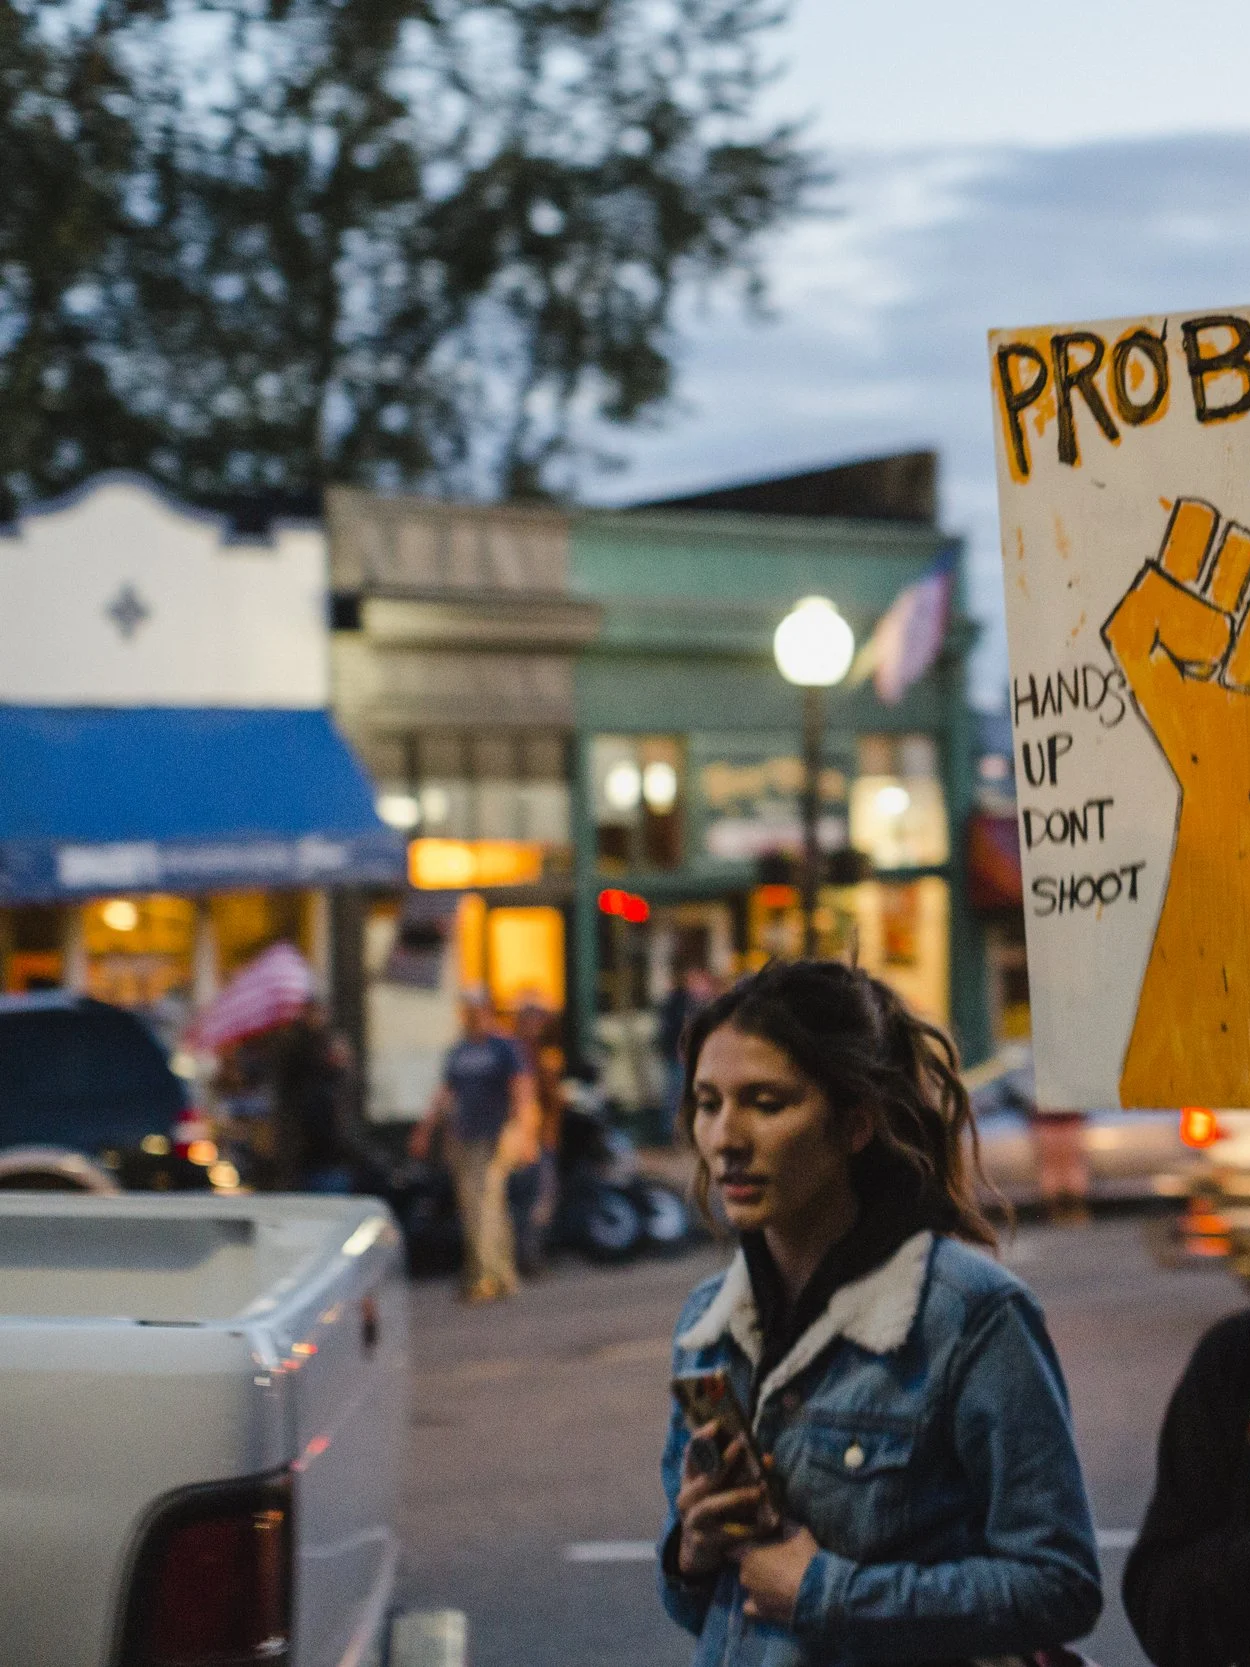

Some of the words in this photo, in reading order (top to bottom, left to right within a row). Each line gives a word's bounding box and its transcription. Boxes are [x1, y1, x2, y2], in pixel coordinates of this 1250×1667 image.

[994, 319, 1169, 481] PRO
[1013, 664, 1127, 729] HANDS
[1022, 731, 1073, 787] UP
[1022, 796, 1114, 850] DONT
[1031, 860, 1147, 917] SHOOT
